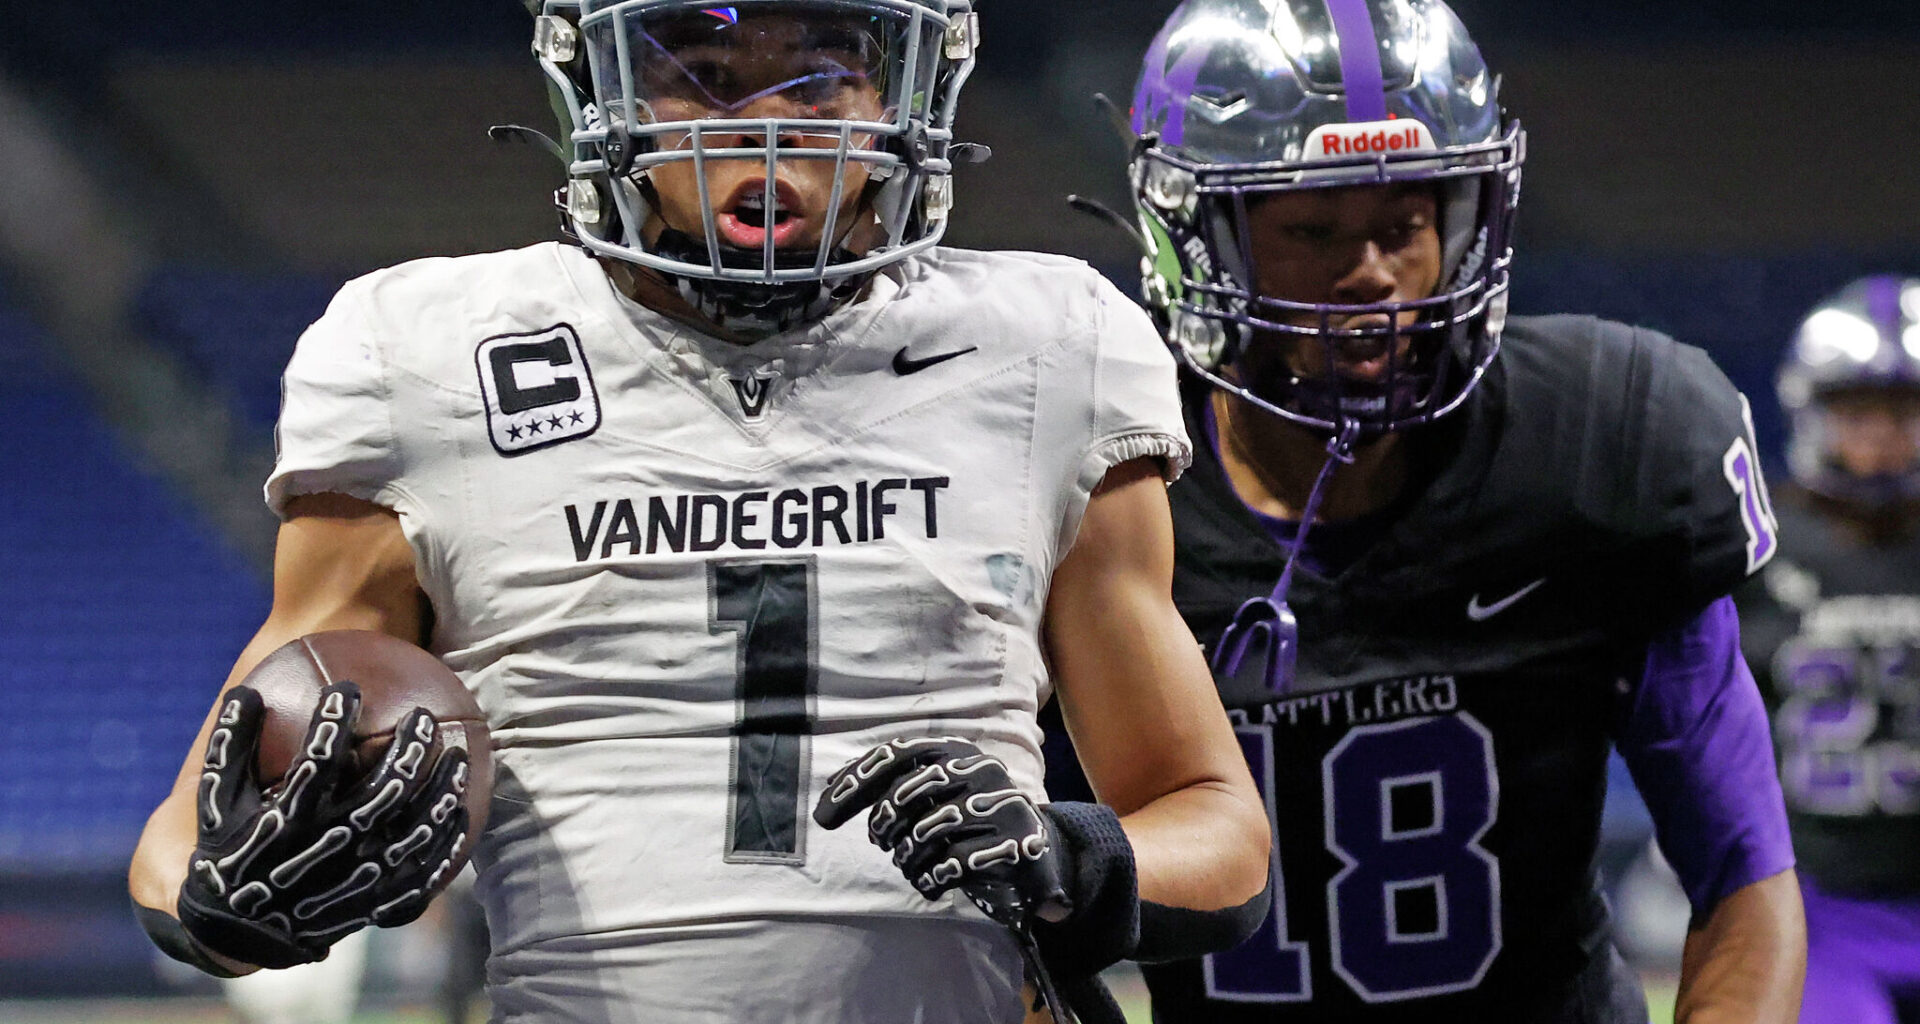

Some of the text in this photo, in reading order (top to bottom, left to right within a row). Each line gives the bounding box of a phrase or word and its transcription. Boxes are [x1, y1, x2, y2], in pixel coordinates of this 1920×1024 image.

[1322, 127, 1419, 155] Riddell
[489, 336, 581, 416] C
[565, 476, 950, 562] VANDEGRIFT
[1723, 391, 1779, 577] 1
[705, 554, 819, 866] 1
[1203, 709, 1503, 1004] 18
